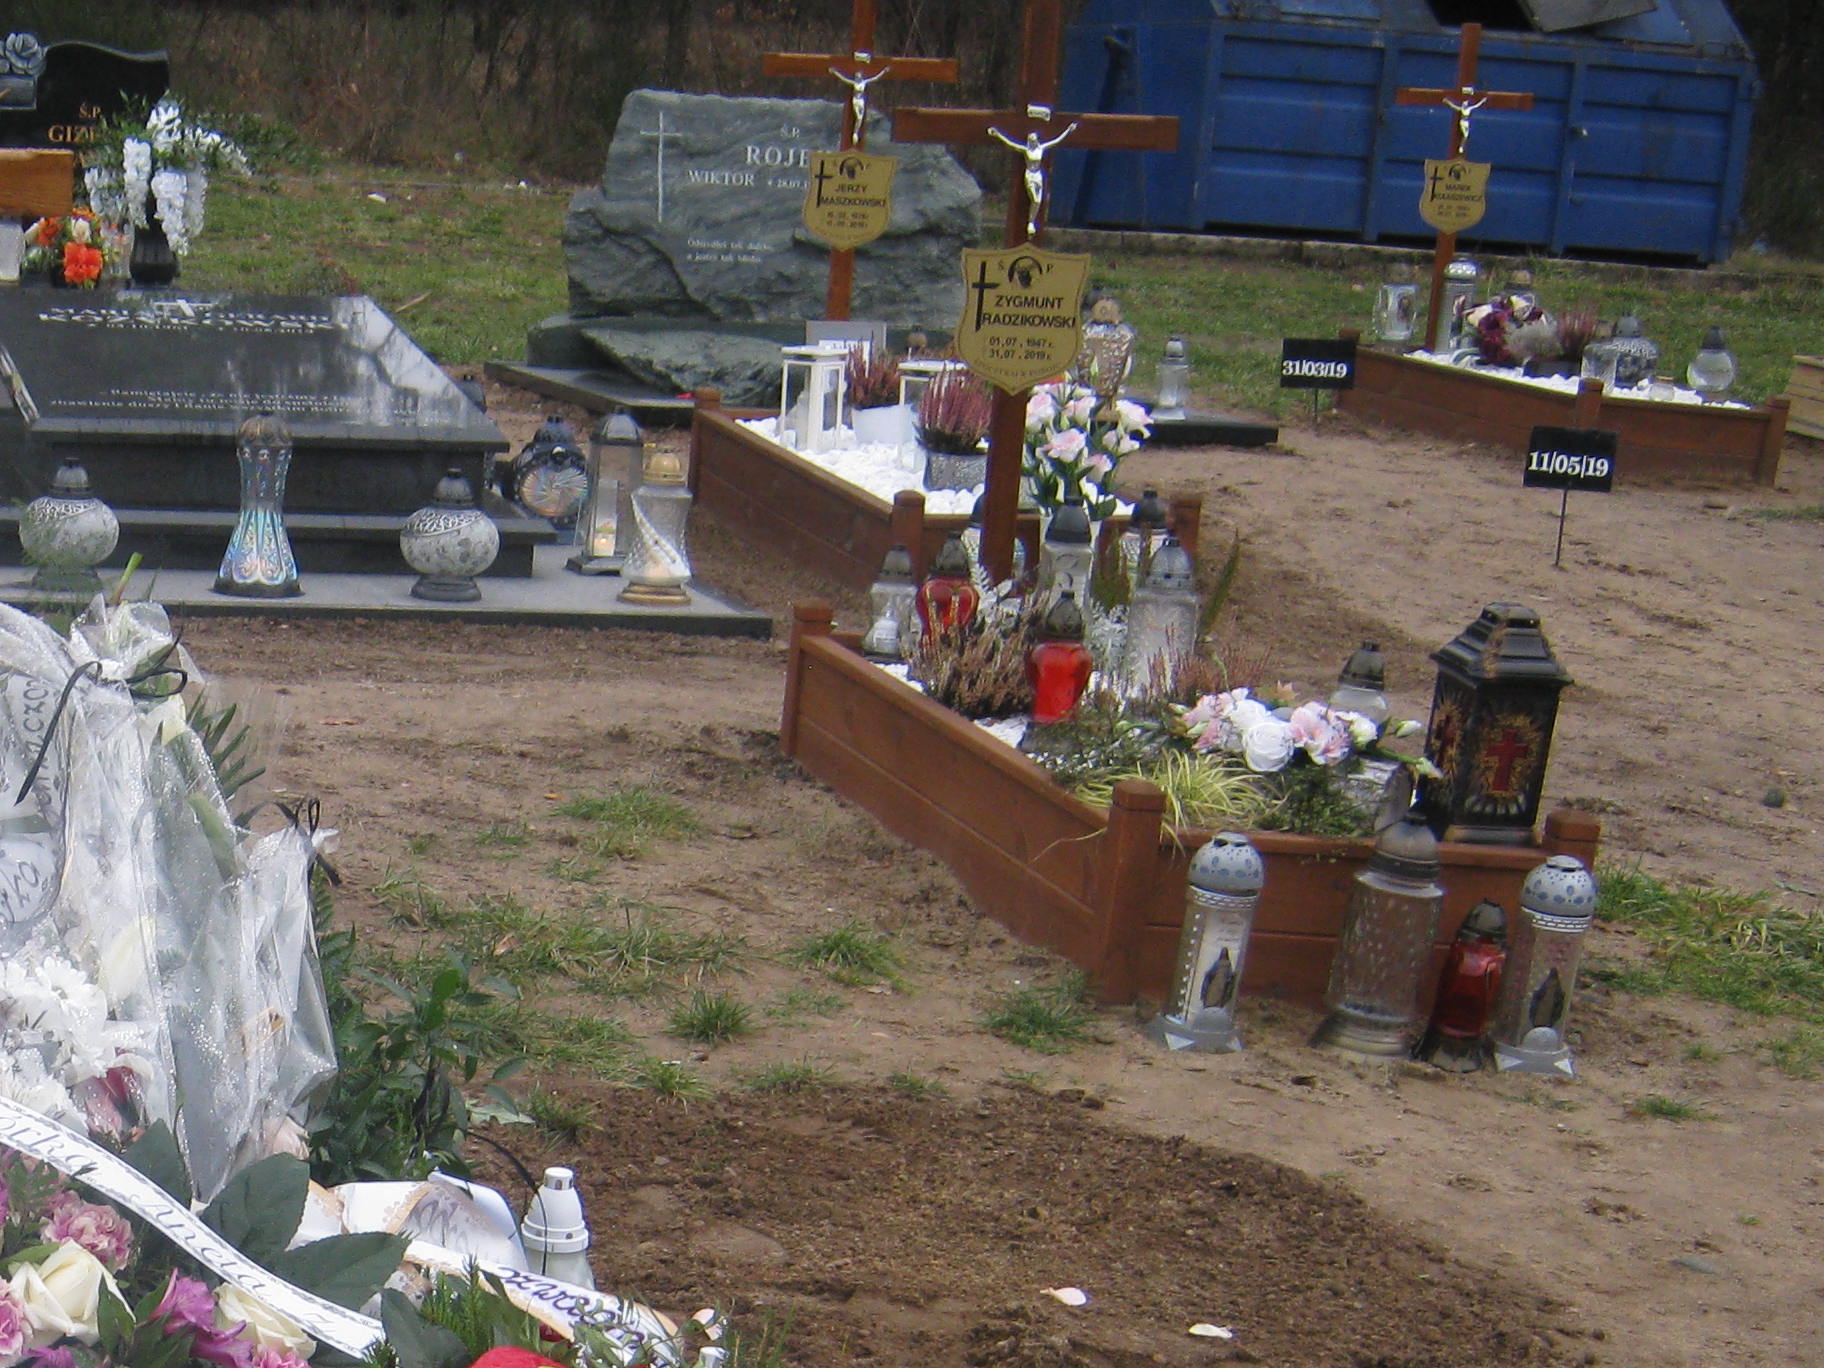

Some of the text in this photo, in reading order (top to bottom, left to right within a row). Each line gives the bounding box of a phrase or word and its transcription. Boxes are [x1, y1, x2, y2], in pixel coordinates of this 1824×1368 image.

[687, 170, 754, 187] WIKTOR
[994, 295, 1064, 310] ZYGMUNT
[981, 312, 1076, 329] RADZIKOWSKI
[1282, 358, 1347, 379] 31/03/19
[1528, 450, 1610, 479] 11/05/19
